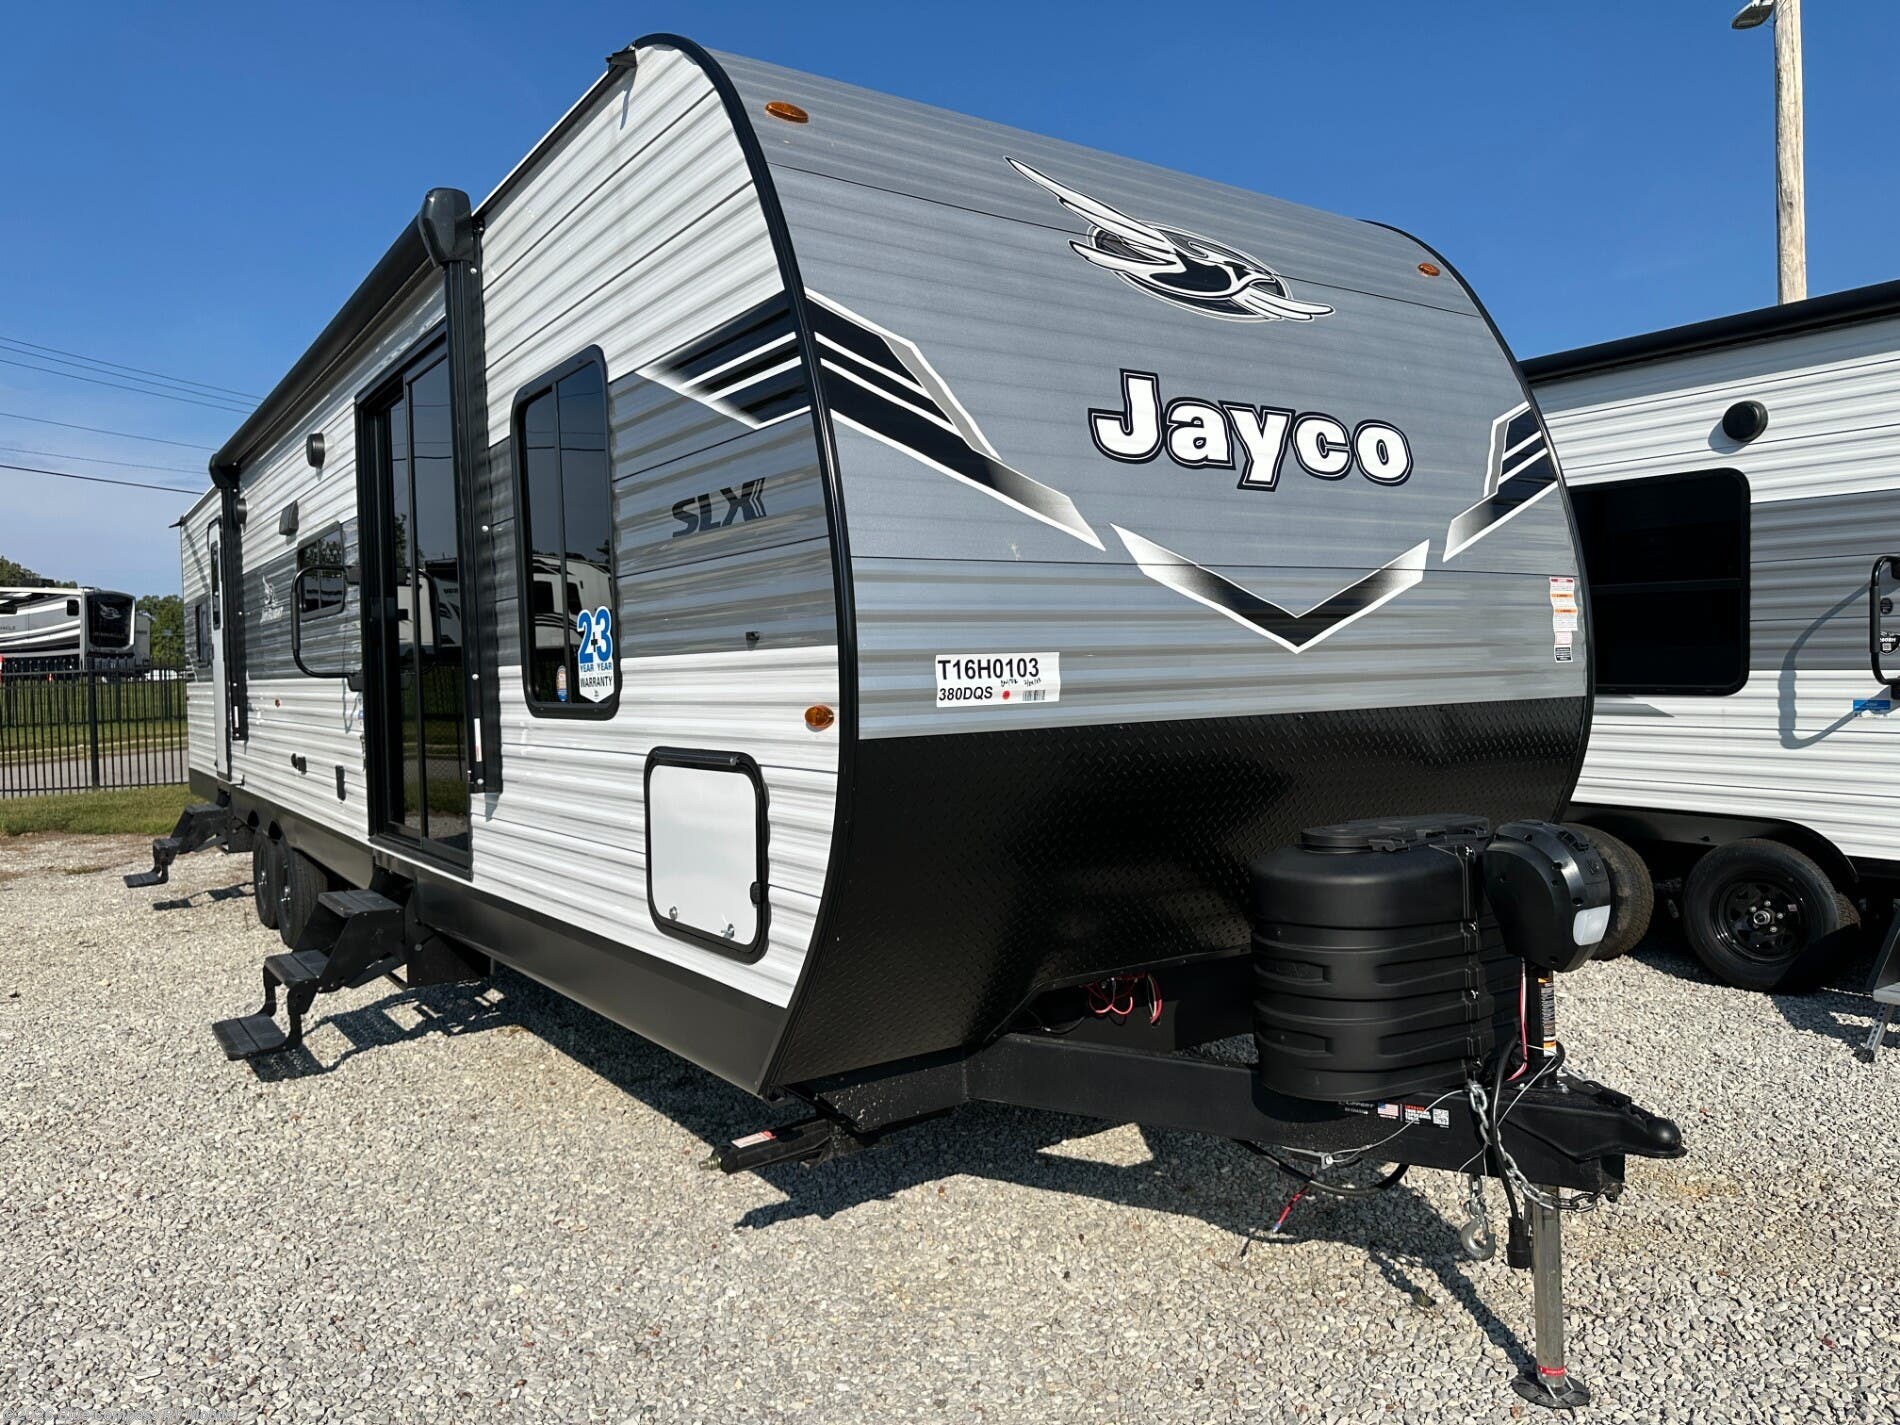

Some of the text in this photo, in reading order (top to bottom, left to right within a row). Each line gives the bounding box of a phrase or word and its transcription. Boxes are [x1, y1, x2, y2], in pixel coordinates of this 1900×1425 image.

[1088, 368, 1414, 492] Jayco
[672, 477, 767, 537] SLX
[580, 661, 612, 672] YEAR YEAR
[938, 657, 1039, 680] T16H0103
[580, 676, 612, 687] WARRANTY
[938, 686, 993, 701] 380DQS
